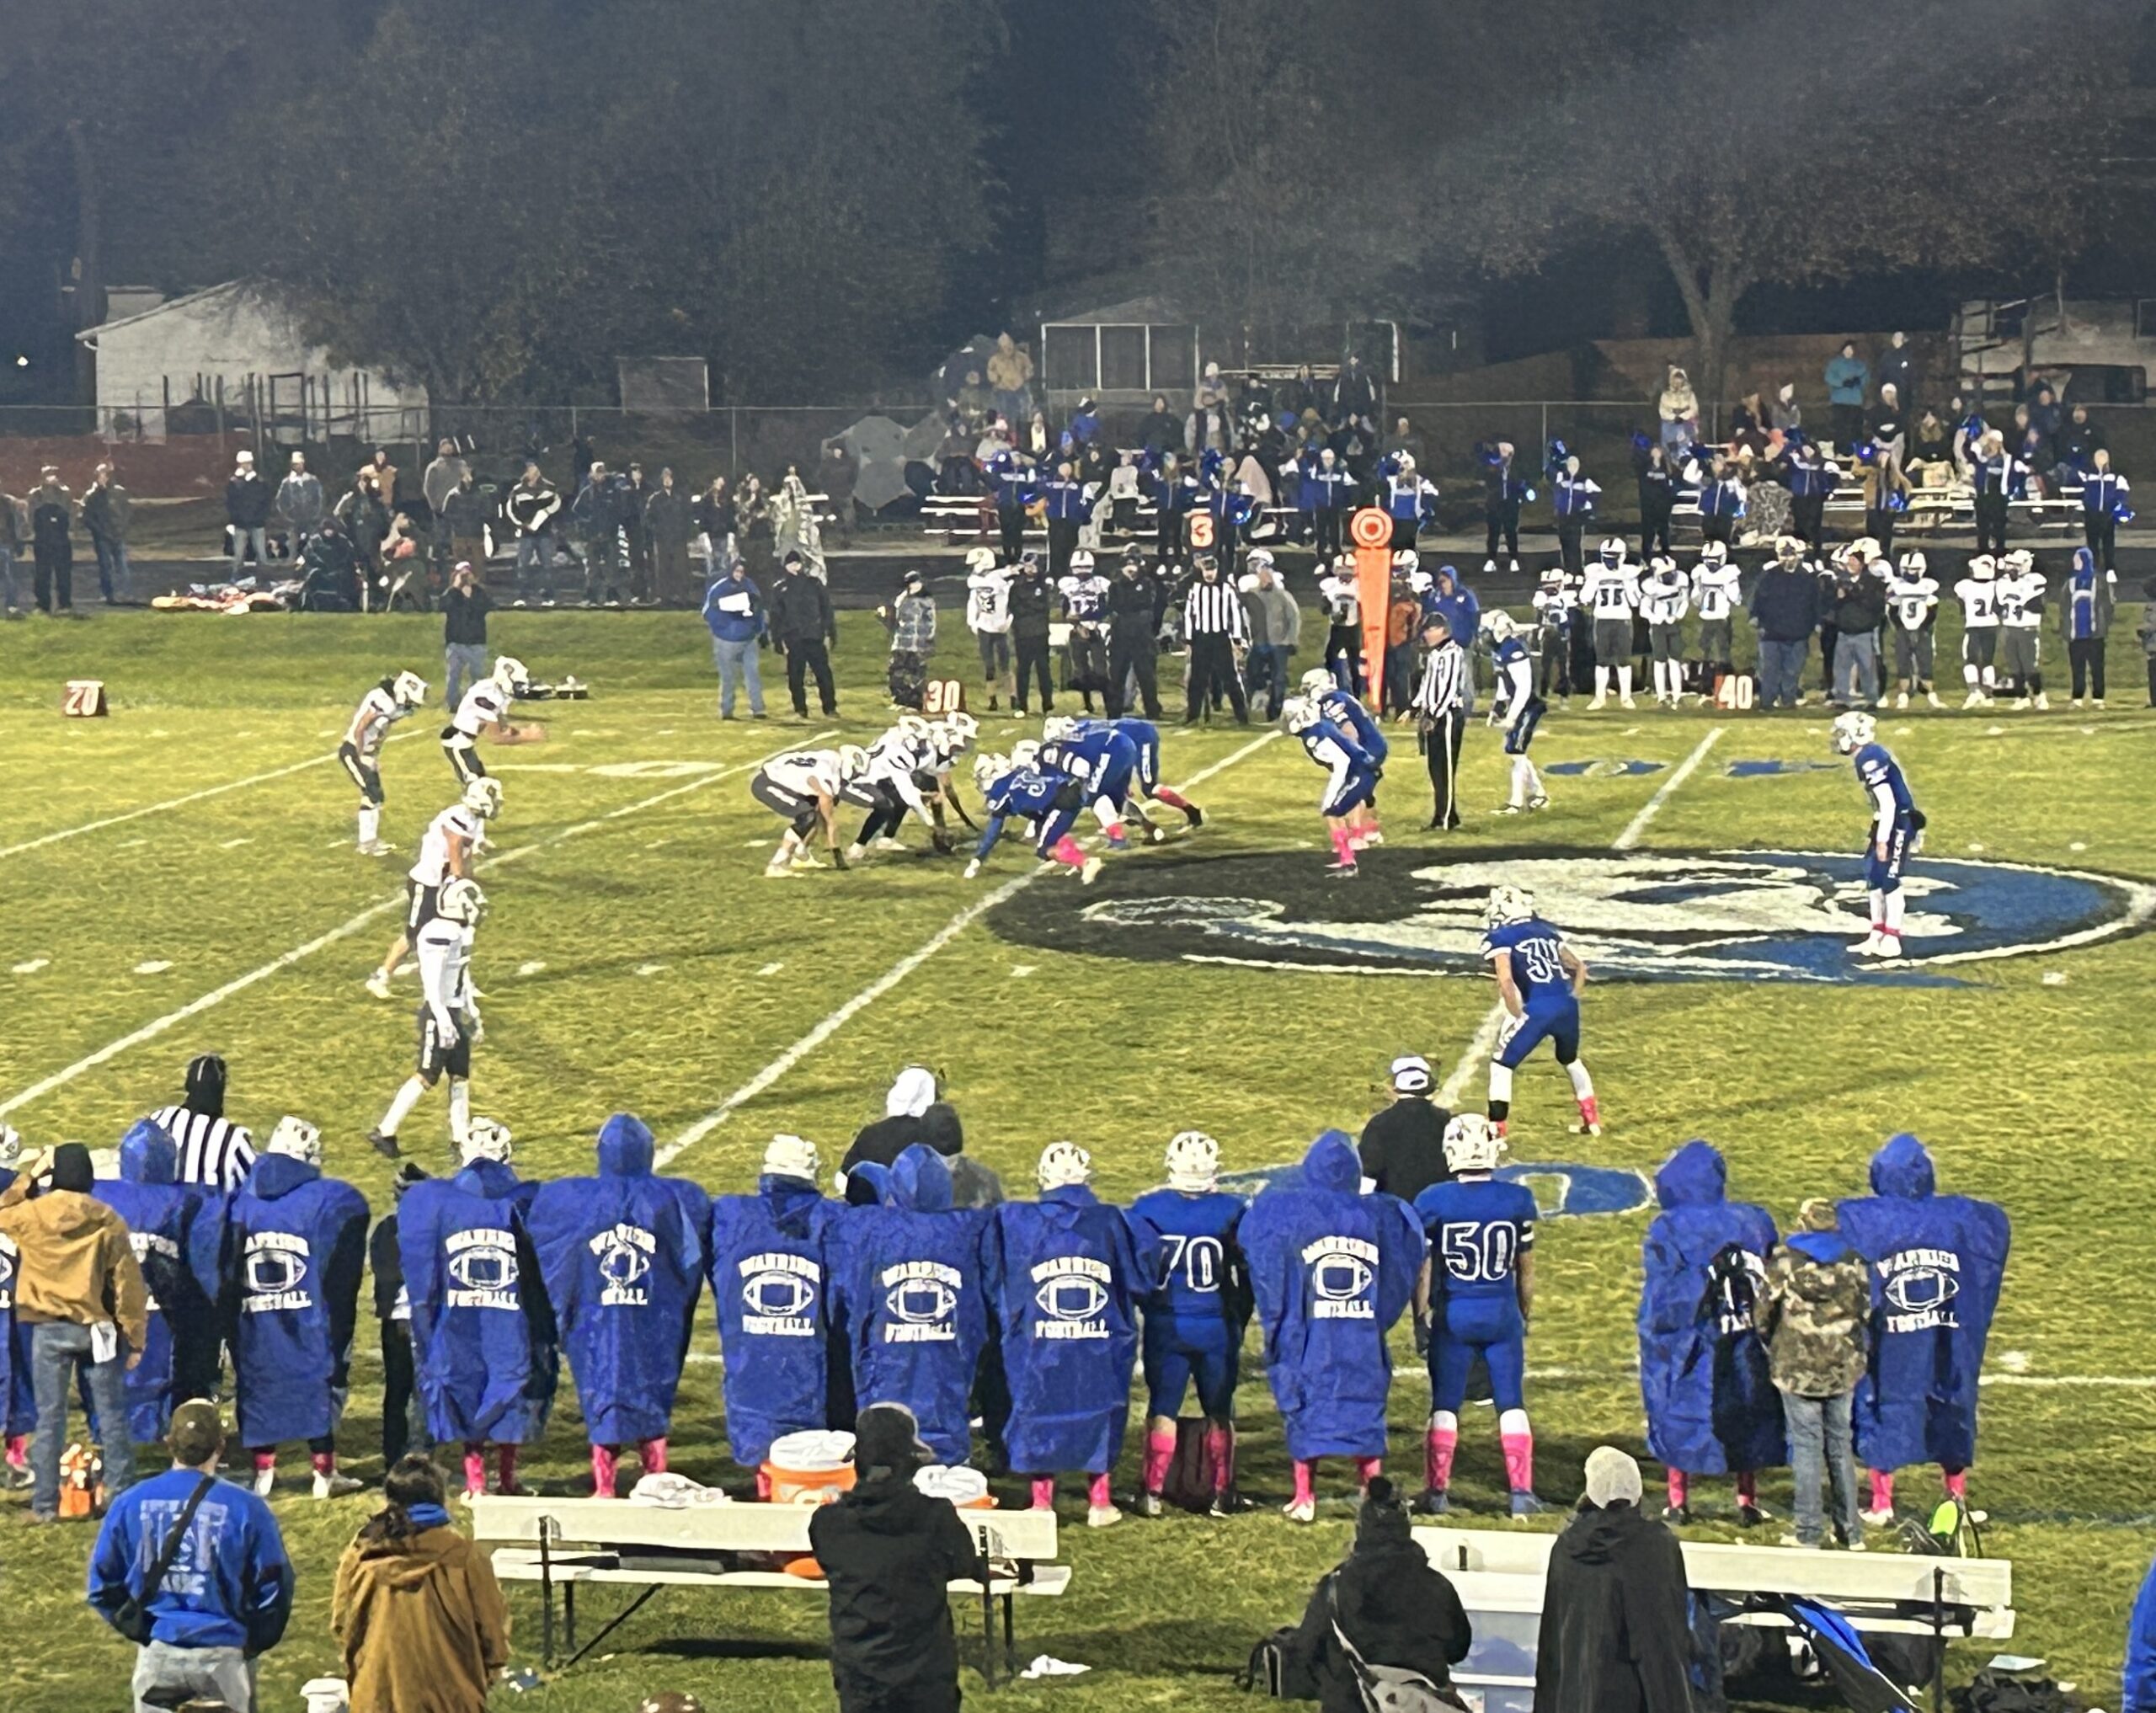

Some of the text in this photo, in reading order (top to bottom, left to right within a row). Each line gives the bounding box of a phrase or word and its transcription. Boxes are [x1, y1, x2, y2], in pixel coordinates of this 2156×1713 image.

[66, 686, 99, 716] 20
[926, 680, 960, 713] 30
[1718, 674, 1753, 710] 40
[1155, 1234, 1224, 1293] 70
[1441, 1220, 1517, 1281] 50
